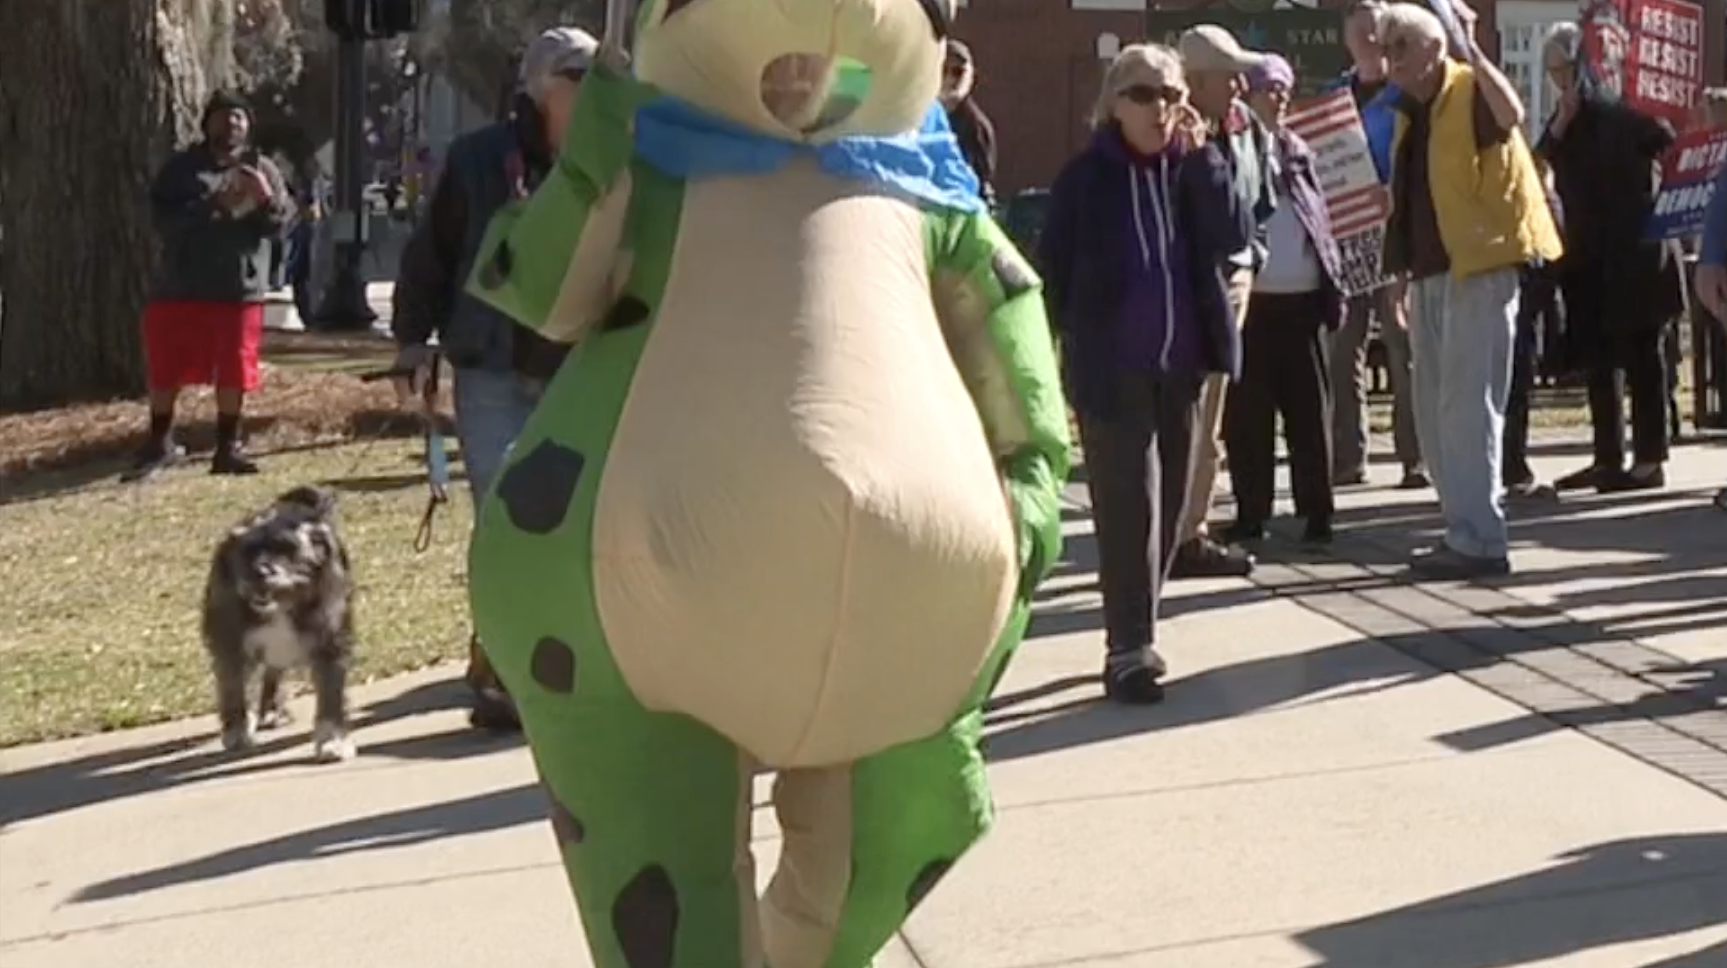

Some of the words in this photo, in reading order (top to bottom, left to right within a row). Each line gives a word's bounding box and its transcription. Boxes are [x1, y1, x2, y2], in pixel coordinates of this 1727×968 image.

[1641, 5, 1698, 45] RESIST
[1638, 36, 1698, 78] RESIST
[1635, 68, 1698, 110] RESIST
